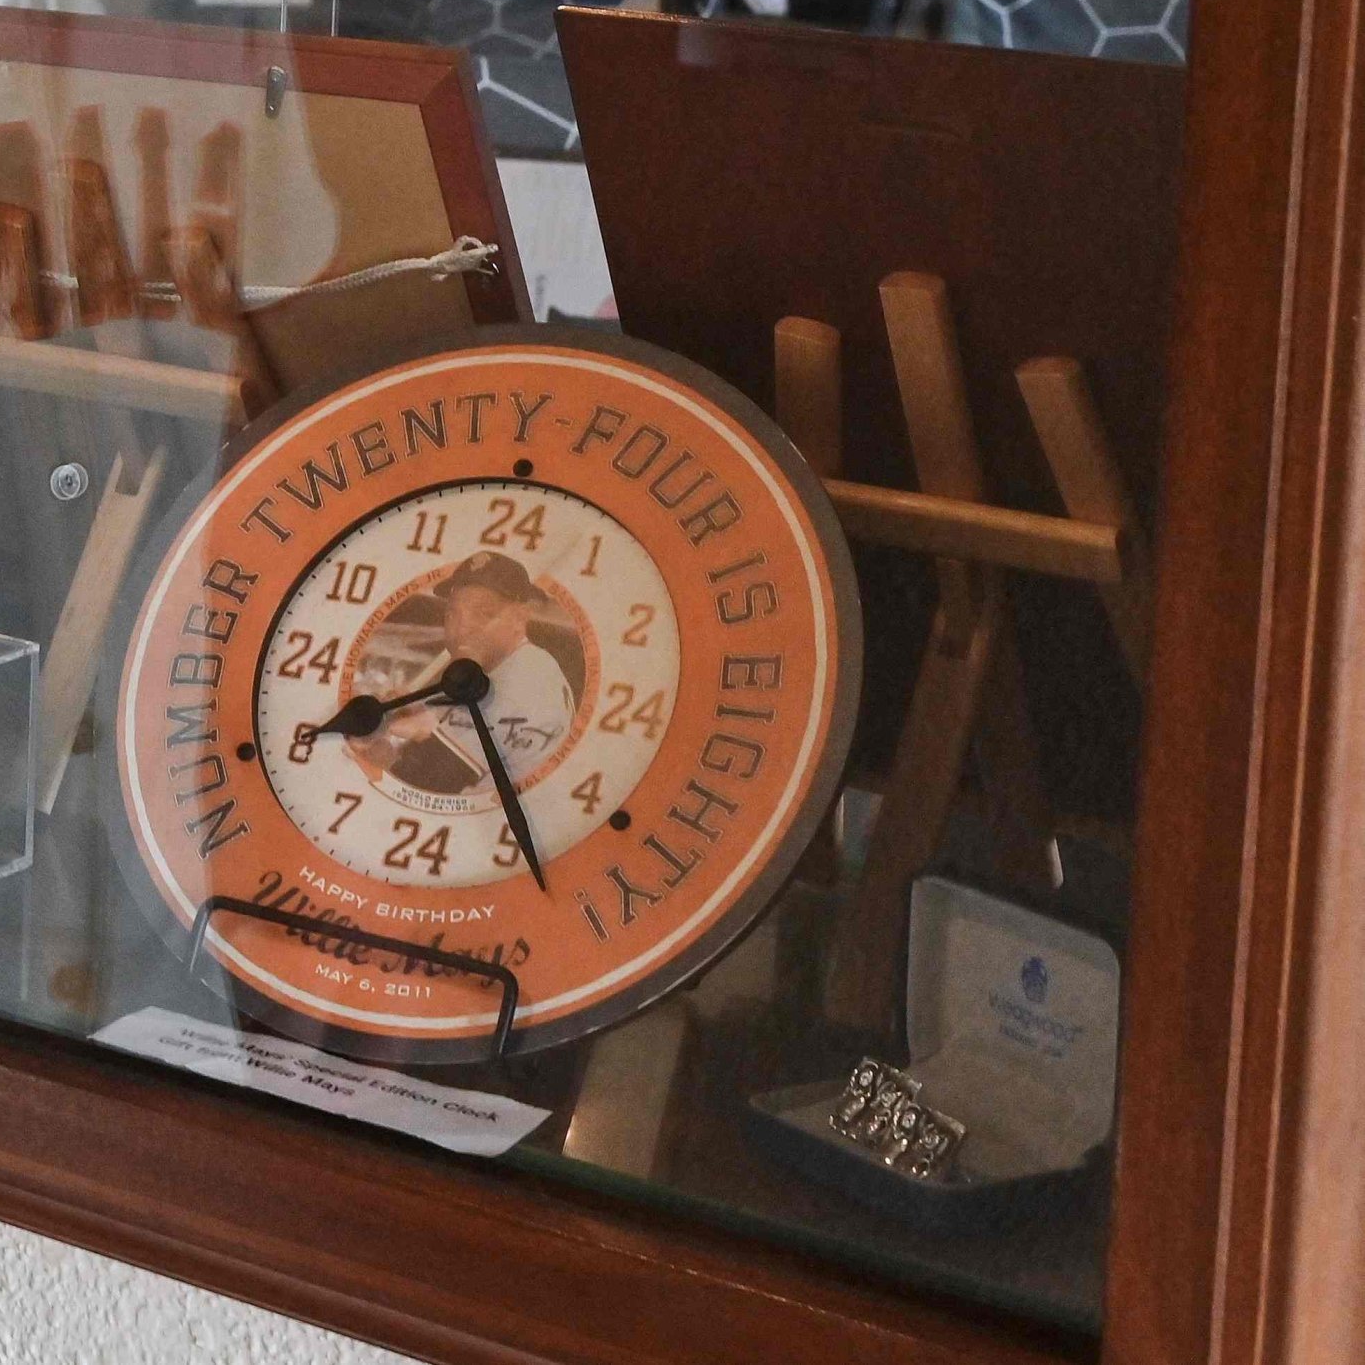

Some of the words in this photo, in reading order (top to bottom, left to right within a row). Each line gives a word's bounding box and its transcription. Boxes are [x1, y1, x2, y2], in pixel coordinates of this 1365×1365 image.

[240, 391, 746, 549] TWENTY-FOUR
[407, 511, 449, 556] 11
[479, 497, 546, 551] 24
[579, 534, 602, 577] 1
[324, 561, 378, 605] 10
[706, 552, 783, 627] IS
[344, 603, 386, 668] HOWARD
[622, 603, 657, 646] 2
[277, 633, 343, 686] 24
[165, 555, 263, 861] NUMBER
[599, 683, 665, 739] 24
[328, 792, 363, 834] 7
[570, 770, 604, 814] 4
[574, 652, 784, 943] EIGHTY!
[384, 820, 451, 877] 24
[492, 823, 523, 869] 5
[299, 865, 369, 910] HAPPY
[375, 902, 496, 923] BIRTHDAY
[315, 963, 353, 985] MAY
[359, 977, 376, 993] 6,
[384, 982, 432, 999] 2011
[302, 1074, 356, 1097] Mays
[370, 1079, 438, 1106] Edition
[443, 1101, 498, 1123] Clock
